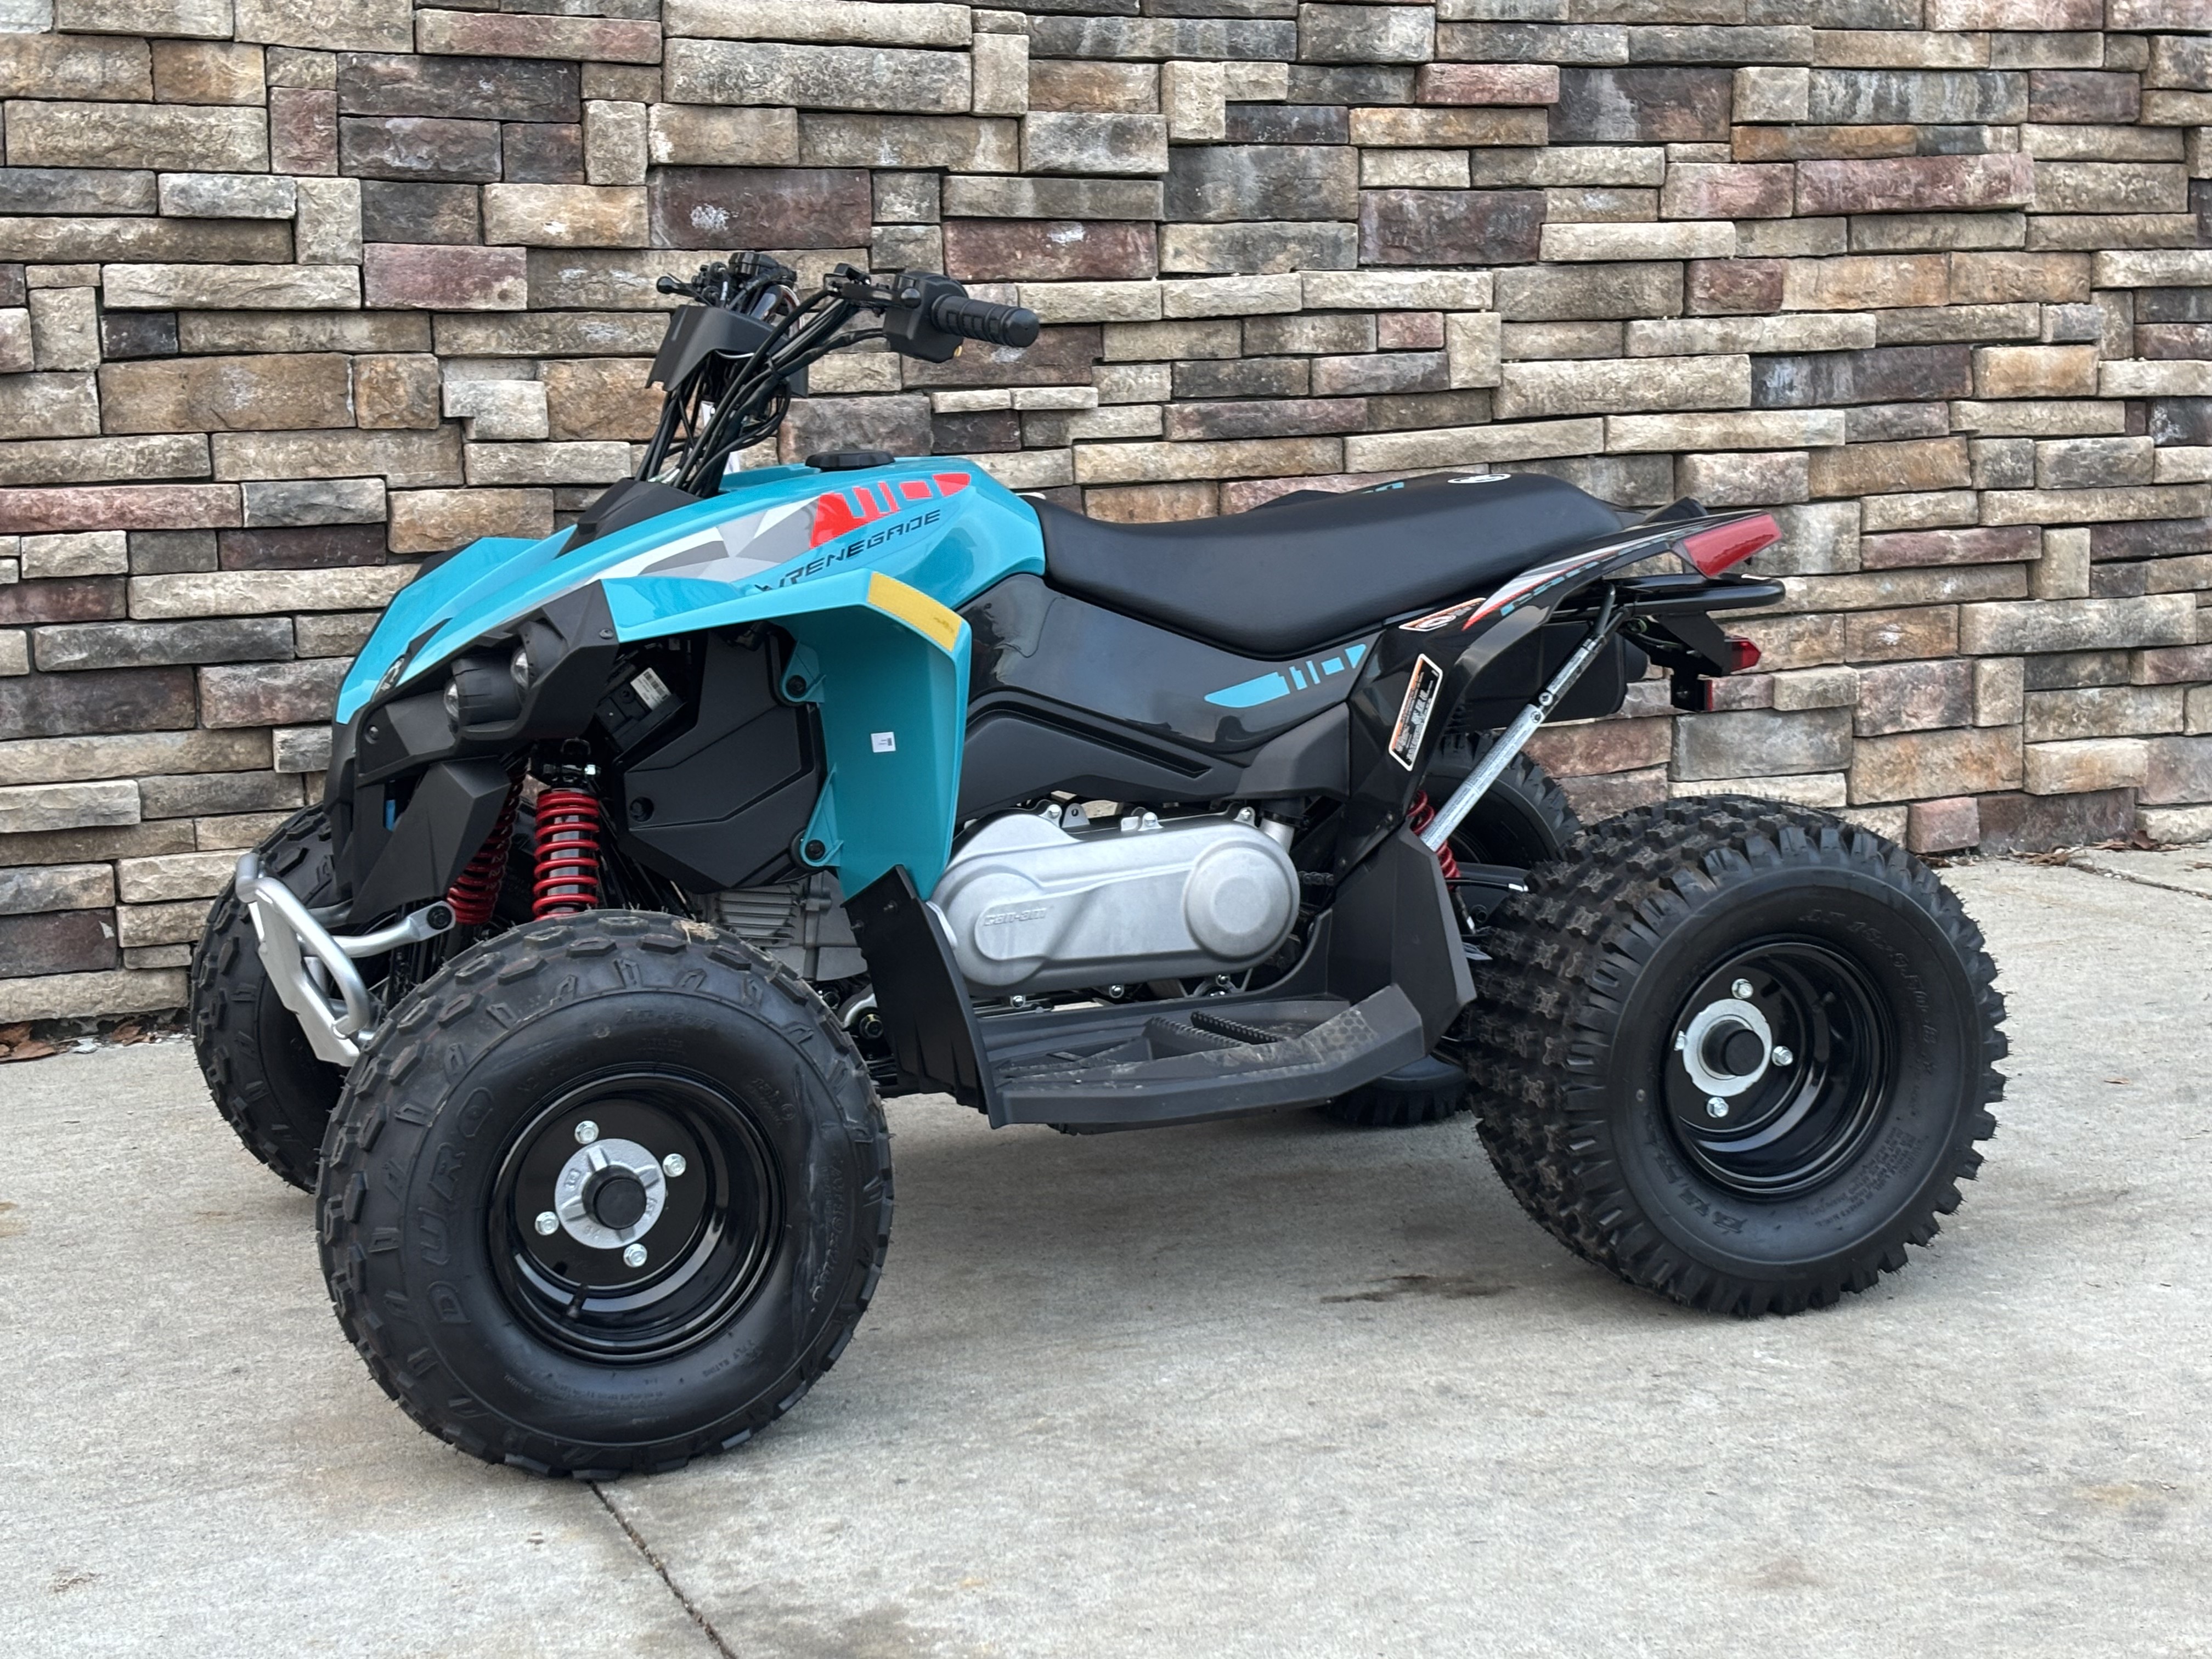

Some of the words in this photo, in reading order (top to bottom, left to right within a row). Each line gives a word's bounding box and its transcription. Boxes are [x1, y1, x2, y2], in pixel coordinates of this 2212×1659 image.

[778, 509, 940, 589] RENEGADE
[983, 907, 1047, 927] can-am
[417, 1087, 494, 1325] DURO
